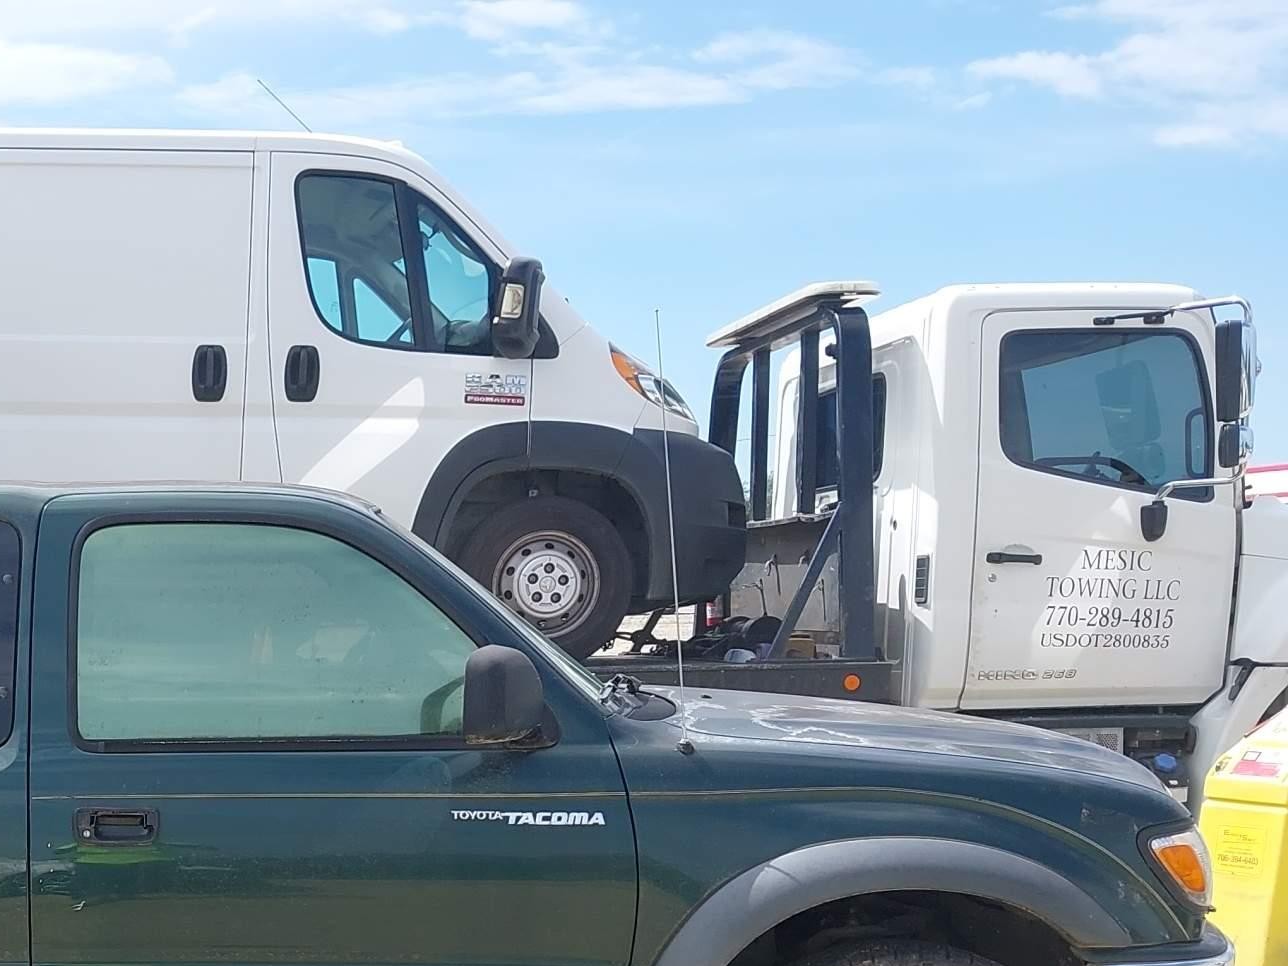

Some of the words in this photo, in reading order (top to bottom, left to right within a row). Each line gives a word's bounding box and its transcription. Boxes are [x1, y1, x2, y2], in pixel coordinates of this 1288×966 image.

[465, 373, 527, 386] RAM
[1081, 549, 1153, 571] MESIC
[1046, 576, 1138, 600] TOWING
[1143, 579, 1182, 601] LLC
[1045, 605, 1174, 629] 770-289-4815
[1040, 633, 1170, 649] USDOT2800835
[451, 810, 503, 820] TOYOTA
[501, 812, 606, 826] TACOMA
